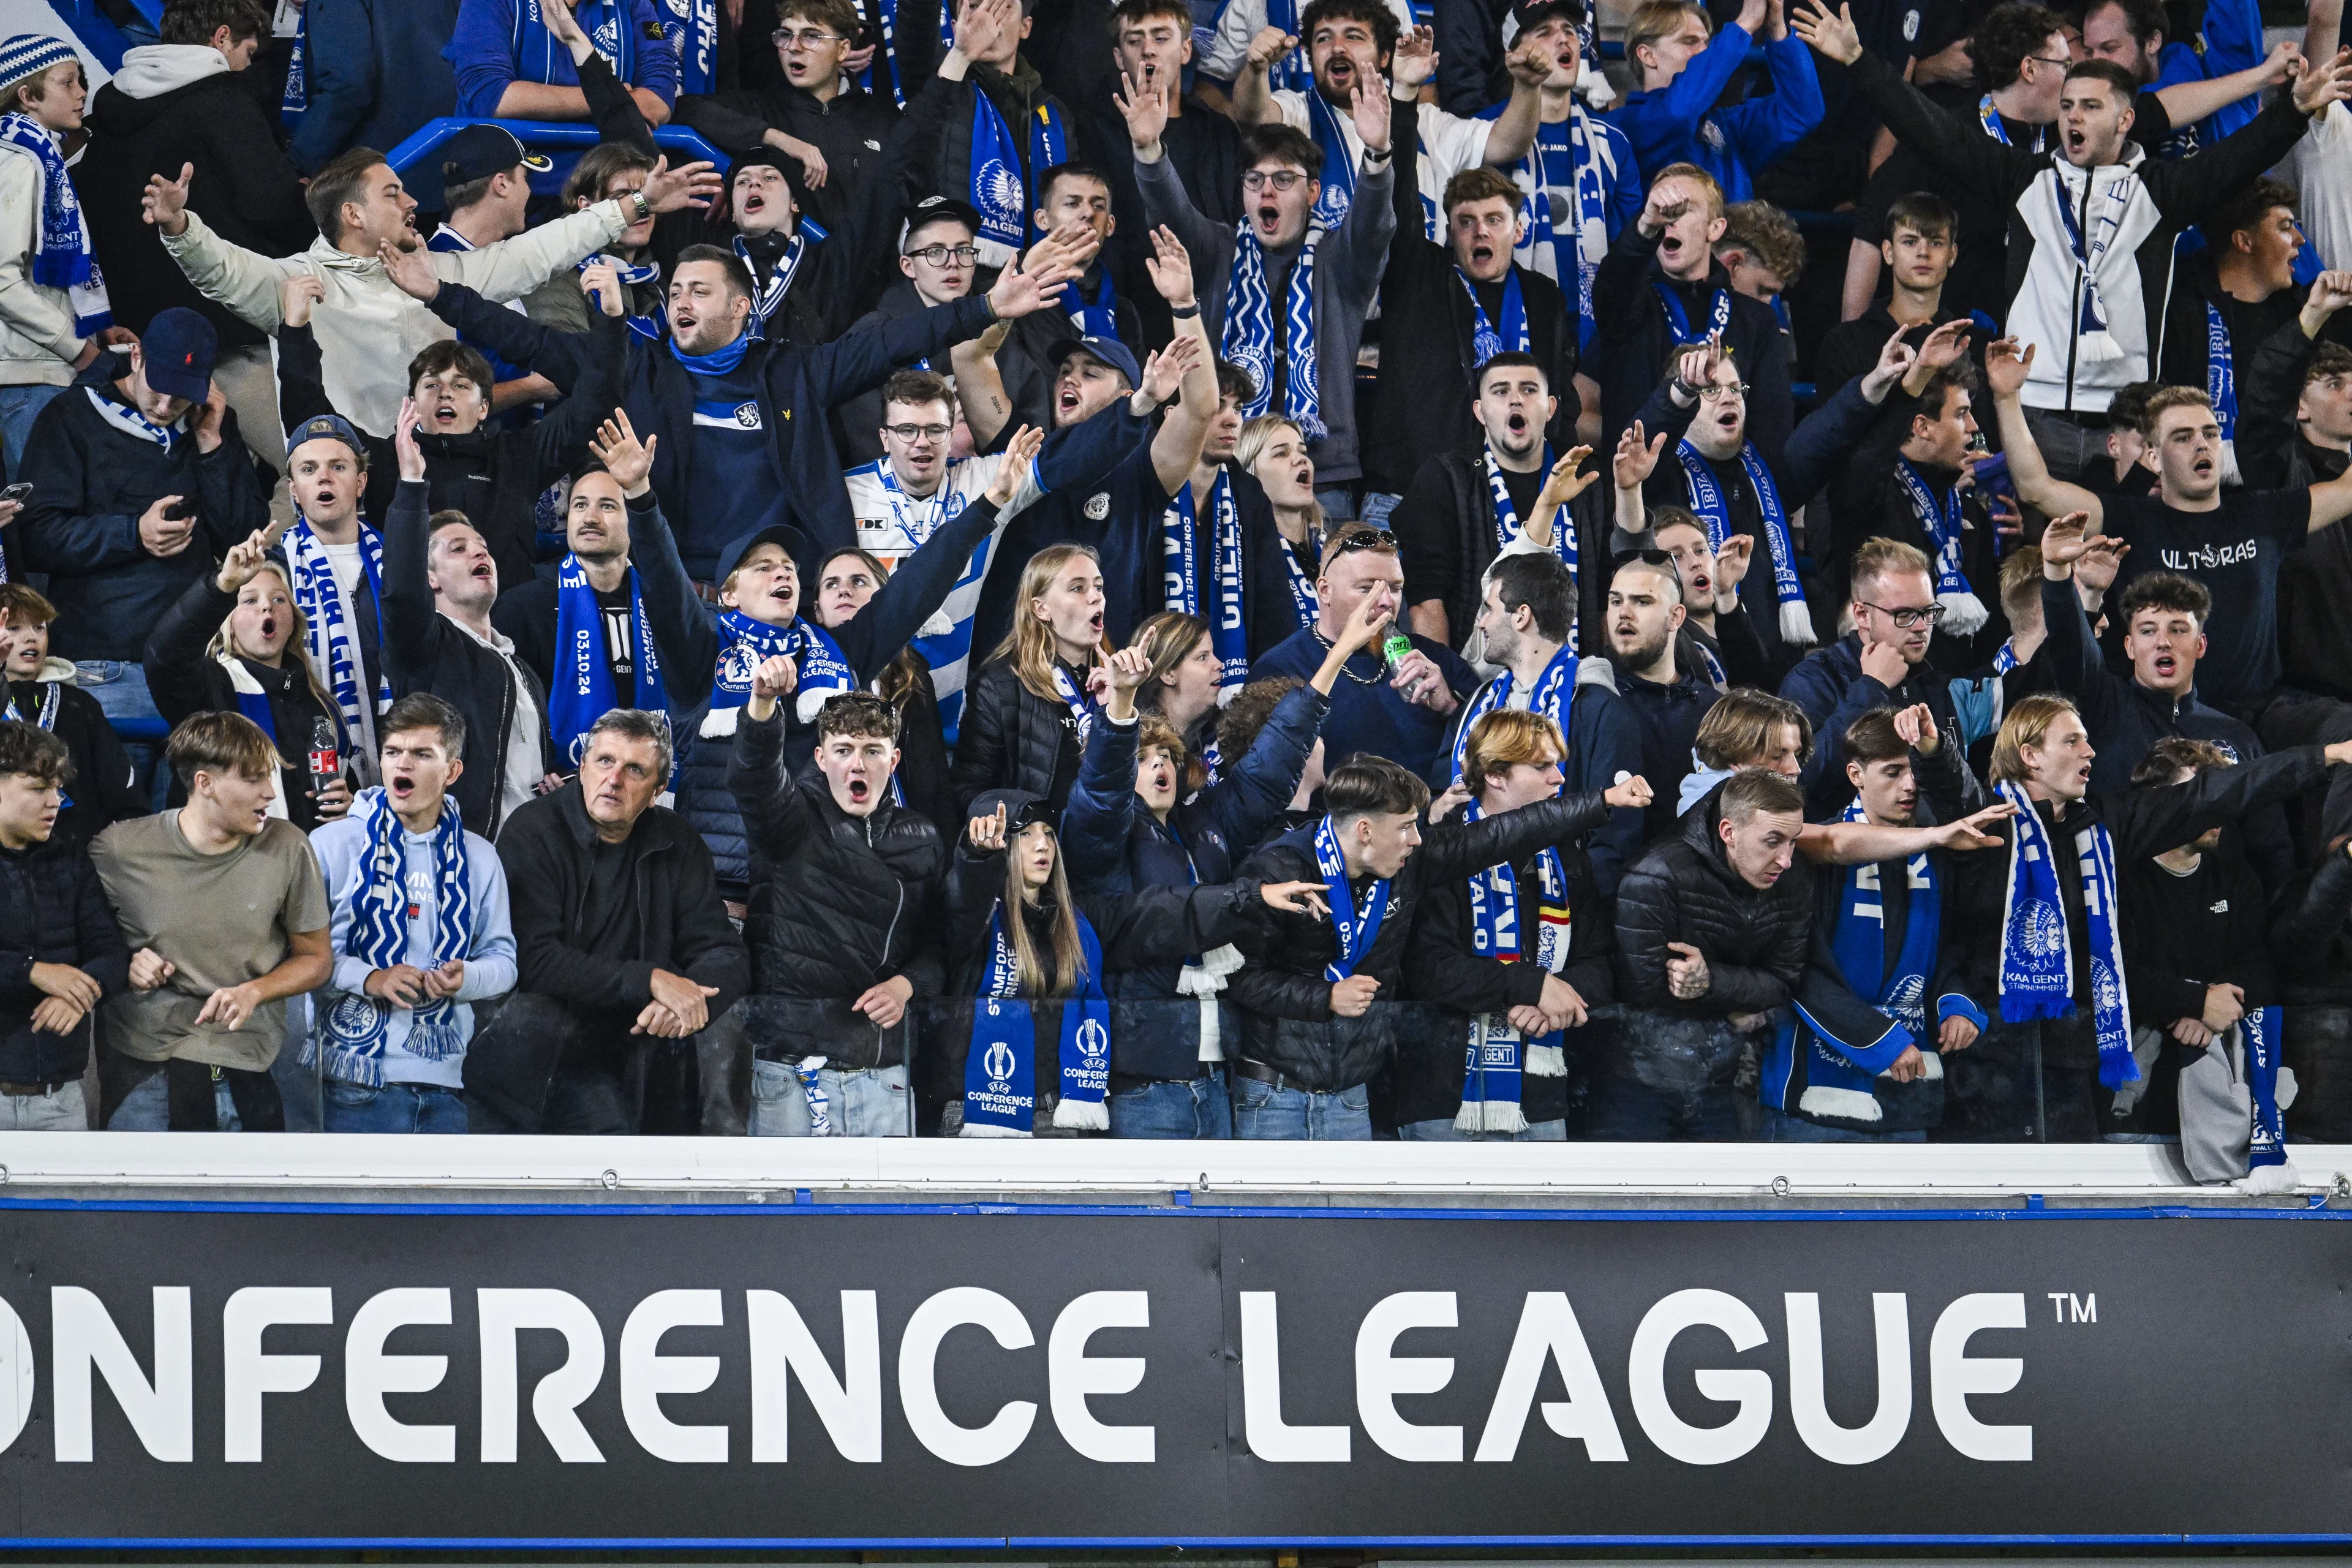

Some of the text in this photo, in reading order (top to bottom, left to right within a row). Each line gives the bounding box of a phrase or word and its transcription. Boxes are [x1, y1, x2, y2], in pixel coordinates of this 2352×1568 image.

[1183, 516, 1194, 591] CONFERENCE
[809, 649, 829, 659] UEFA
[576, 630, 590, 696] 03.10.24
[807, 659, 848, 673] NFERENCE
[722, 682, 750, 690] FOOTBALL
[2006, 973, 2065, 984] KAA GENT
[1483, 1047, 1512, 1063] GENT
[1082, 1058, 1107, 1070] UEFA
[1064, 1067, 1109, 1080] CONFERE
[987, 1082, 1011, 1095] UEFA
[1077, 1079, 1107, 1090] LEAGU
[968, 1091, 1033, 1108] CONFERENCE
[981, 1102, 1017, 1116] LEAGUE
[0, 1284, 1156, 1466] NFERENCE
[1238, 1287, 2033, 1465] LEAGUE
